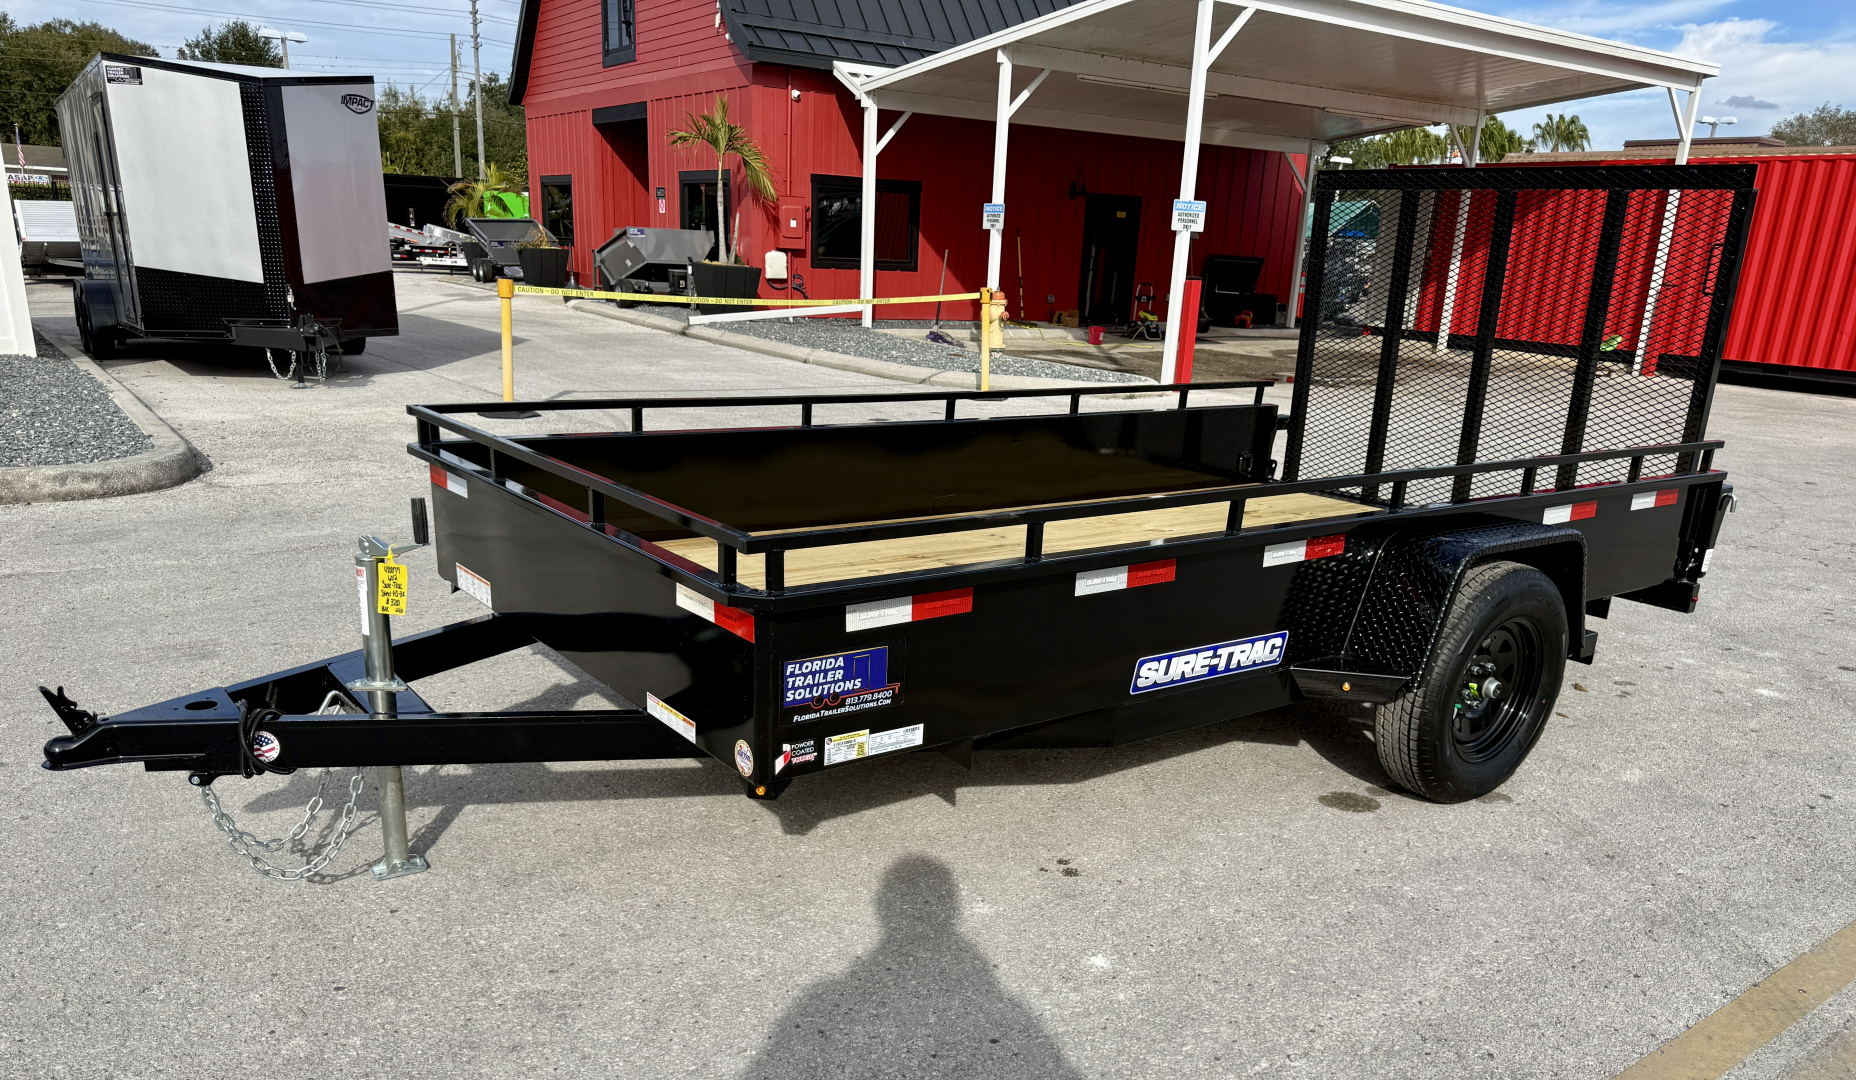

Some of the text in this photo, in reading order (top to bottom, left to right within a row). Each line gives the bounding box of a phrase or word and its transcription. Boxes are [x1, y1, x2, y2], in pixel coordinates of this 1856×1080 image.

[341, 95, 374, 108] IMPACT
[1176, 202, 1204, 211] NOTICE
[1177, 211, 1200, 219] AUTHORIZED
[1177, 217, 1199, 225] PERSONNEL
[517, 286, 544, 295] CAUTION
[575, 290, 594, 298] ENTER
[859, 607, 900, 621] SURE-TRAC
[785, 656, 845, 676] FLORIDA
[1136, 637, 1283, 688] SURE-TRAC
[786, 669, 844, 689] TRAILER
[785, 678, 862, 702] SOLUTIONS
[845, 689, 893, 705] 813.779.8400
[791, 740, 815, 750] POWDER
[791, 746, 815, 757] COATED
